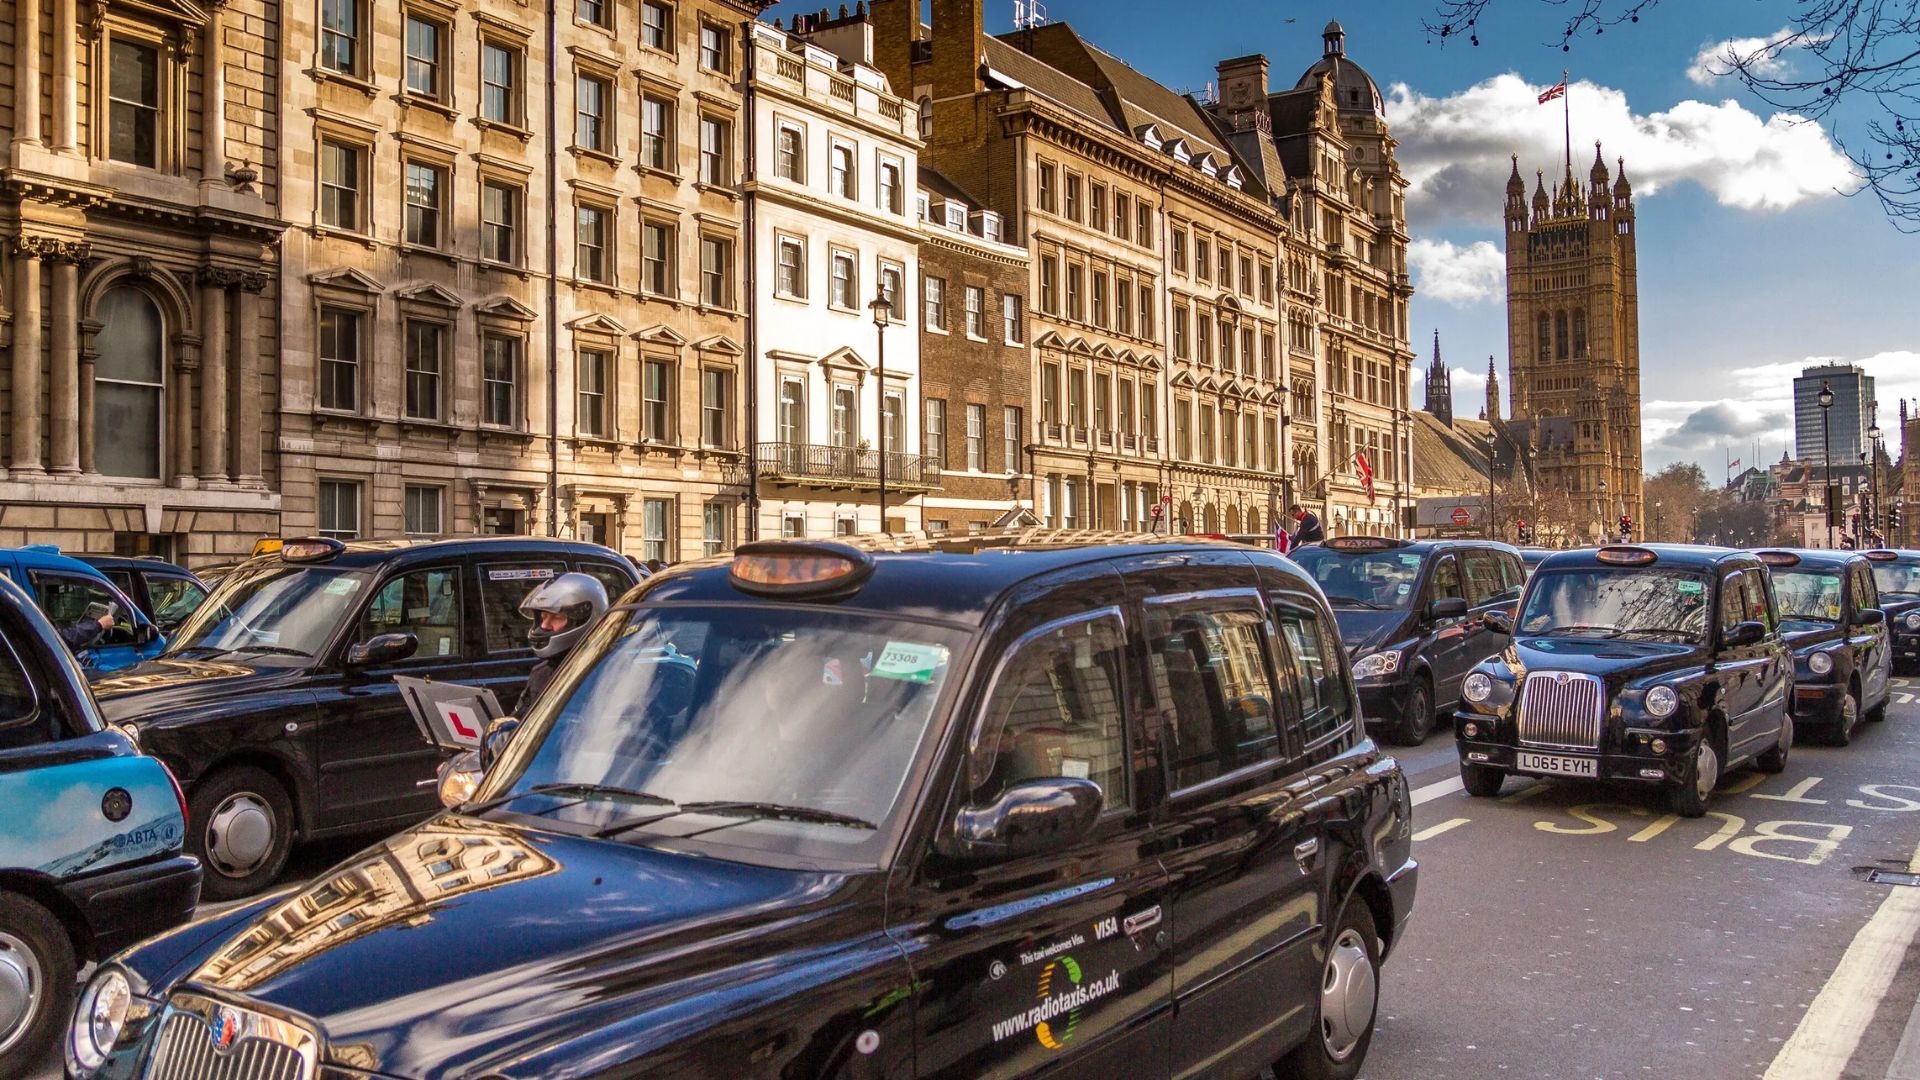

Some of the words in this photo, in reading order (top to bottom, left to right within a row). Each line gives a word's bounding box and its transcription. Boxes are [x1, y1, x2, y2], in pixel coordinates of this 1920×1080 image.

[884, 652, 919, 664] 73308
[448, 711, 478, 738] L
[1523, 754, 1559, 771] LO65
[1562, 758, 1591, 774] EYH
[126, 828, 158, 846] ABTA
[1534, 804, 1854, 866] BUS
[1094, 916, 1118, 941] VISA
[1020, 952, 1034, 965] This
[1033, 946, 1045, 961] taxi
[1045, 940, 1072, 957] welcomes
[992, 969, 1120, 1042] www.radiotaxis.co.uk
